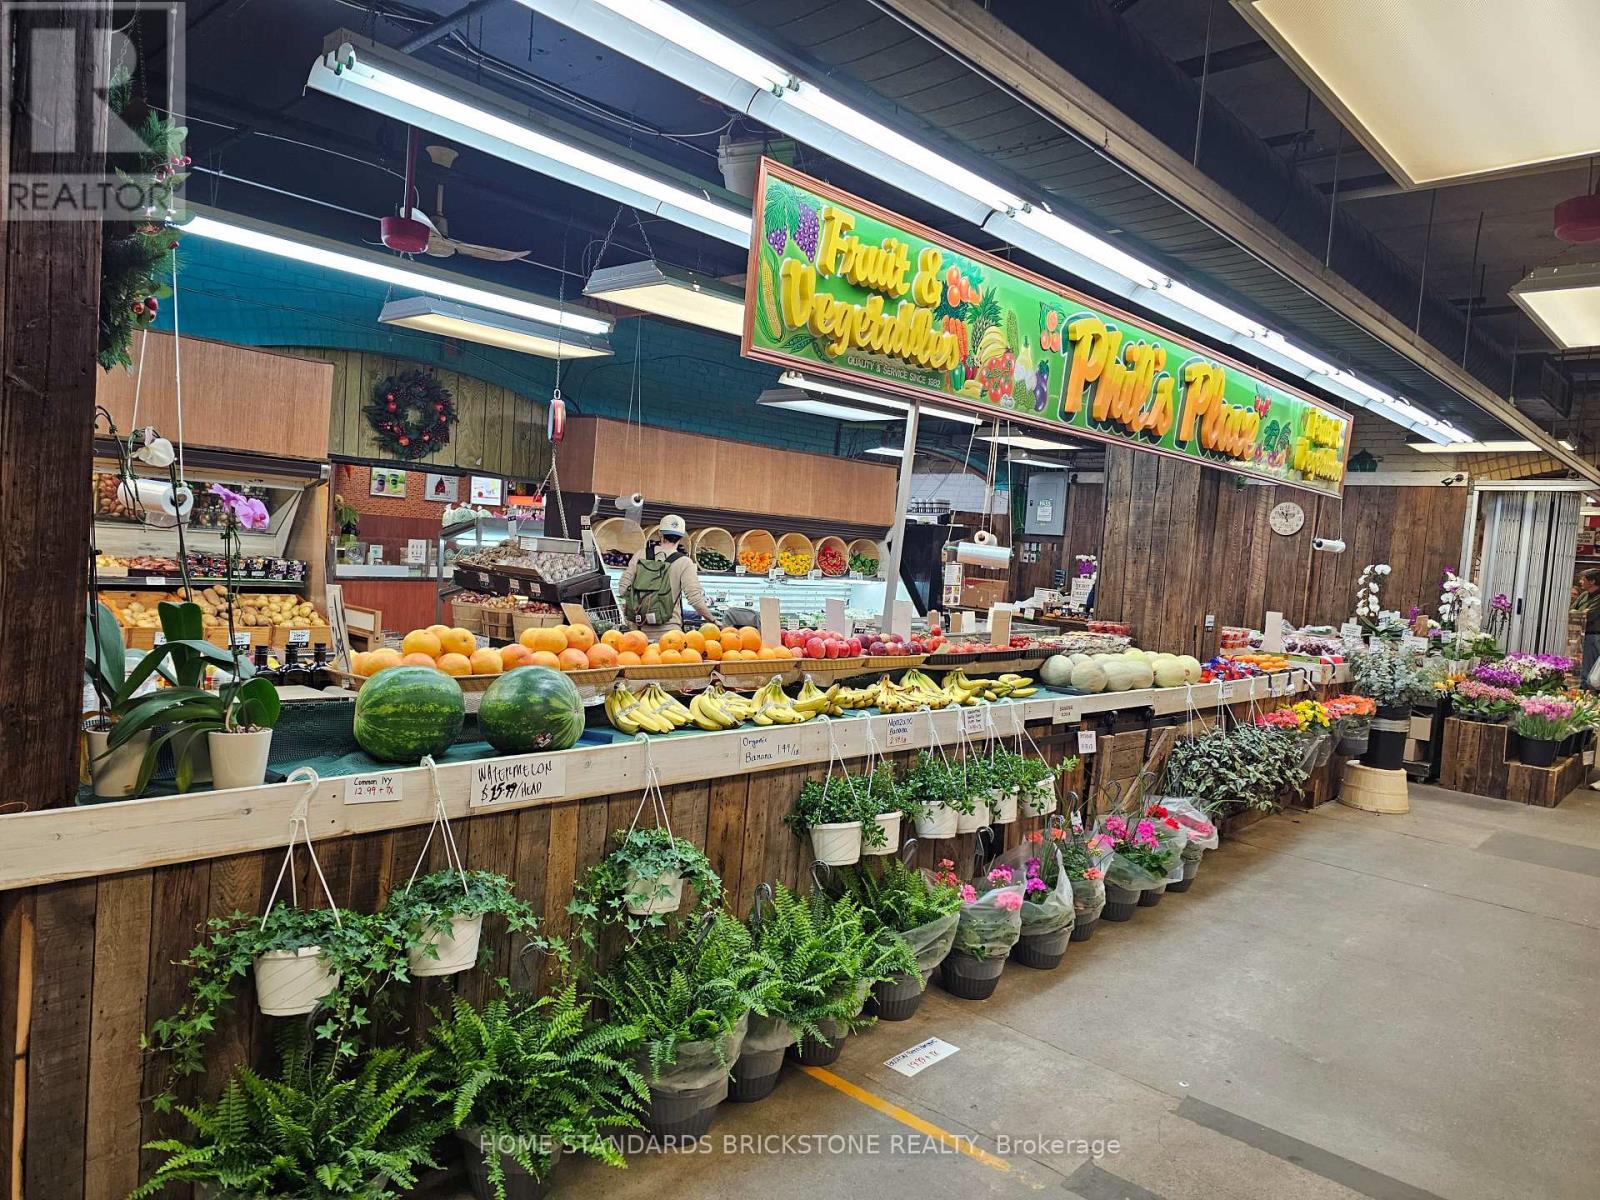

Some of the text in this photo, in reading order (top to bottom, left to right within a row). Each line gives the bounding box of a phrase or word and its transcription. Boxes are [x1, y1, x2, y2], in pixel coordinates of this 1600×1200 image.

[816, 205, 943, 308] Fruit &
[780, 258, 960, 370] Vegetables
[847, 356, 874, 370] QUALITY
[875, 364, 881, 373] &
[883, 365, 908, 380] SERVICE
[909, 372, 927, 385] SINCE
[1061, 313, 1261, 462] Phil's Place
[742, 737, 768, 749] Organic
[745, 752, 773, 763] Banana
[354, 777, 378, 786] Common
[478, 760, 553, 783] WATERMELON
